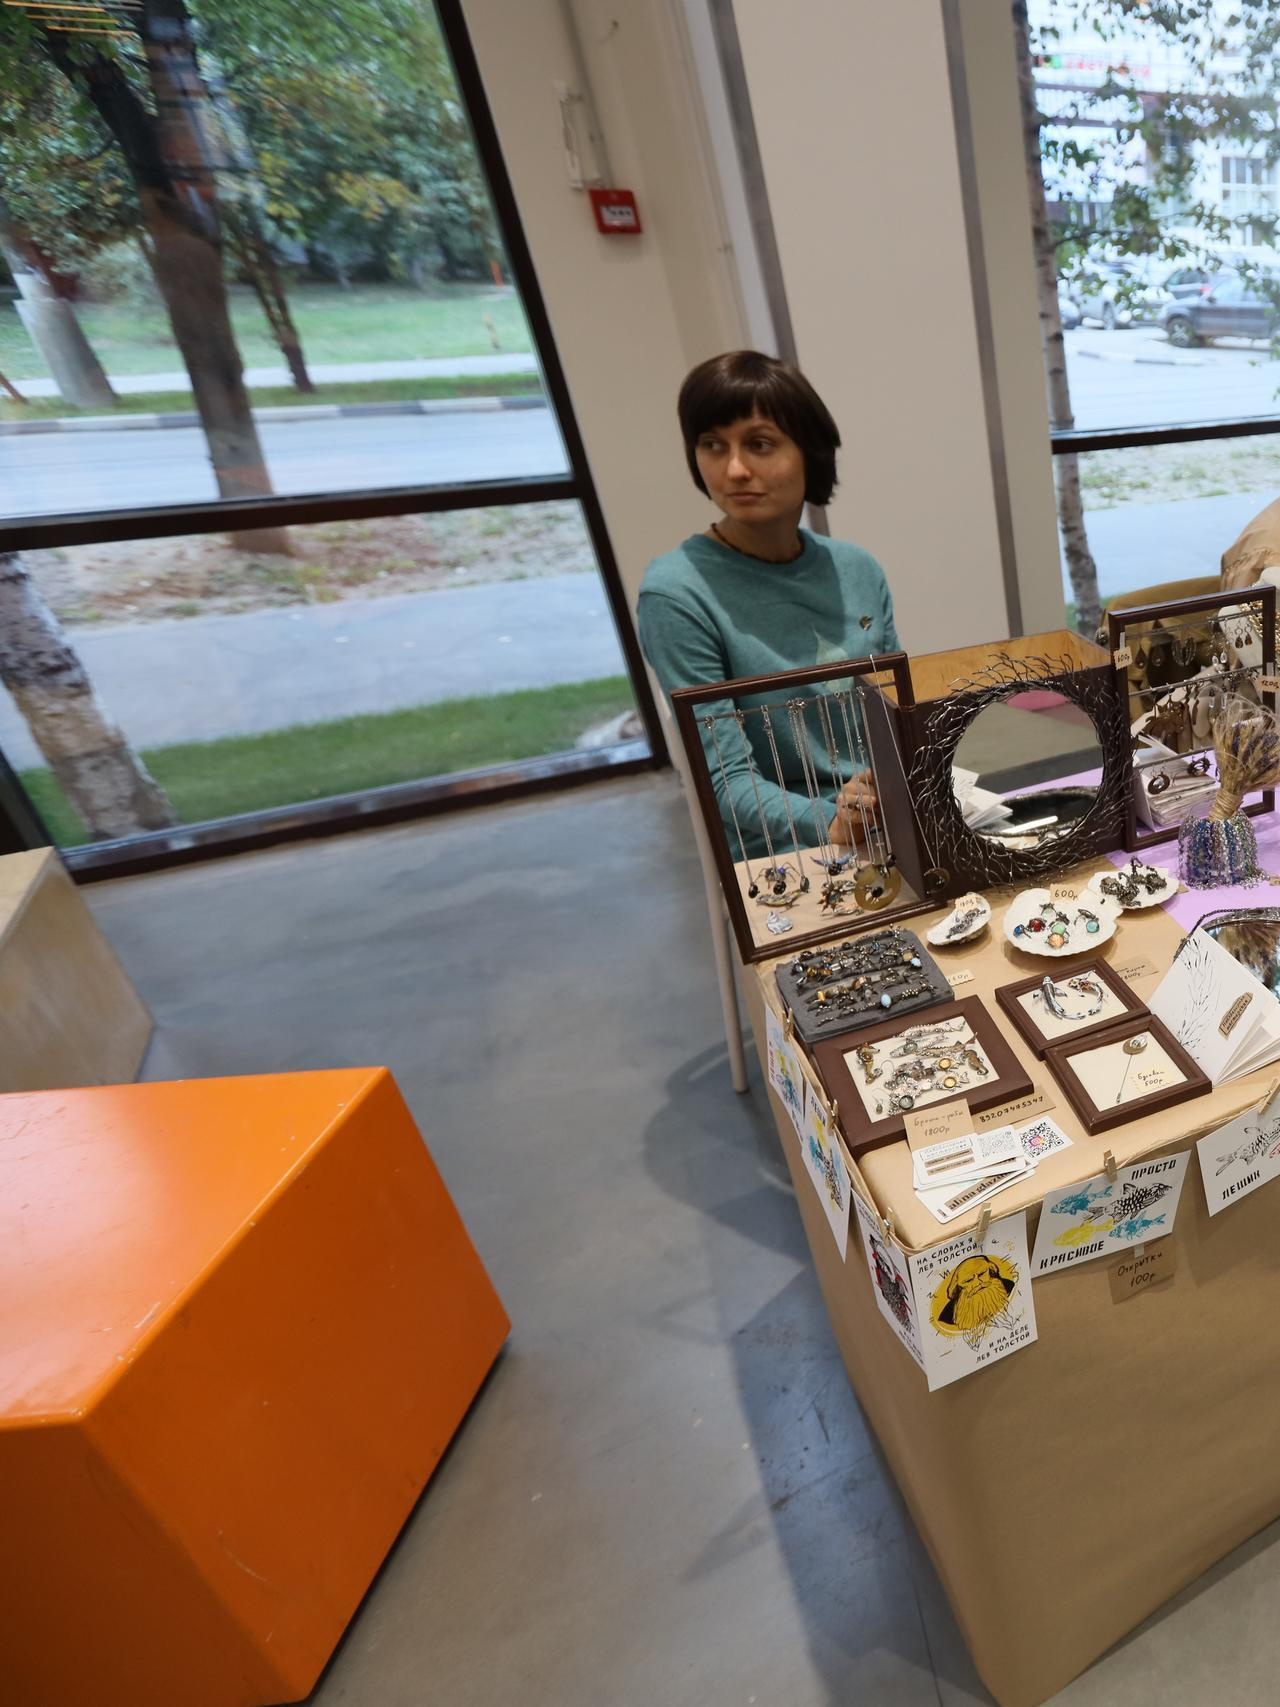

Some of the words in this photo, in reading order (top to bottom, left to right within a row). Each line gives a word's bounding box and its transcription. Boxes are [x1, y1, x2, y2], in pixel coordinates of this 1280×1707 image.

[1131, 1159, 1177, 1181] ПРОСТО
[916, 1257, 928, 1266] НА
[931, 1242, 965, 1259] СЛОВАХ
[1039, 1240, 1105, 1270] КРАСИВОЕ
[918, 1261, 935, 1274] ЛЕВ
[975, 1352, 991, 1364] ЛЕВ
[993, 1331, 1031, 1355] ТОЛСТОЙ
[988, 1341, 994, 1349] И
[996, 1336, 1007, 1344] НА
[1009, 1323, 1030, 1339] ДЕЛЕ
